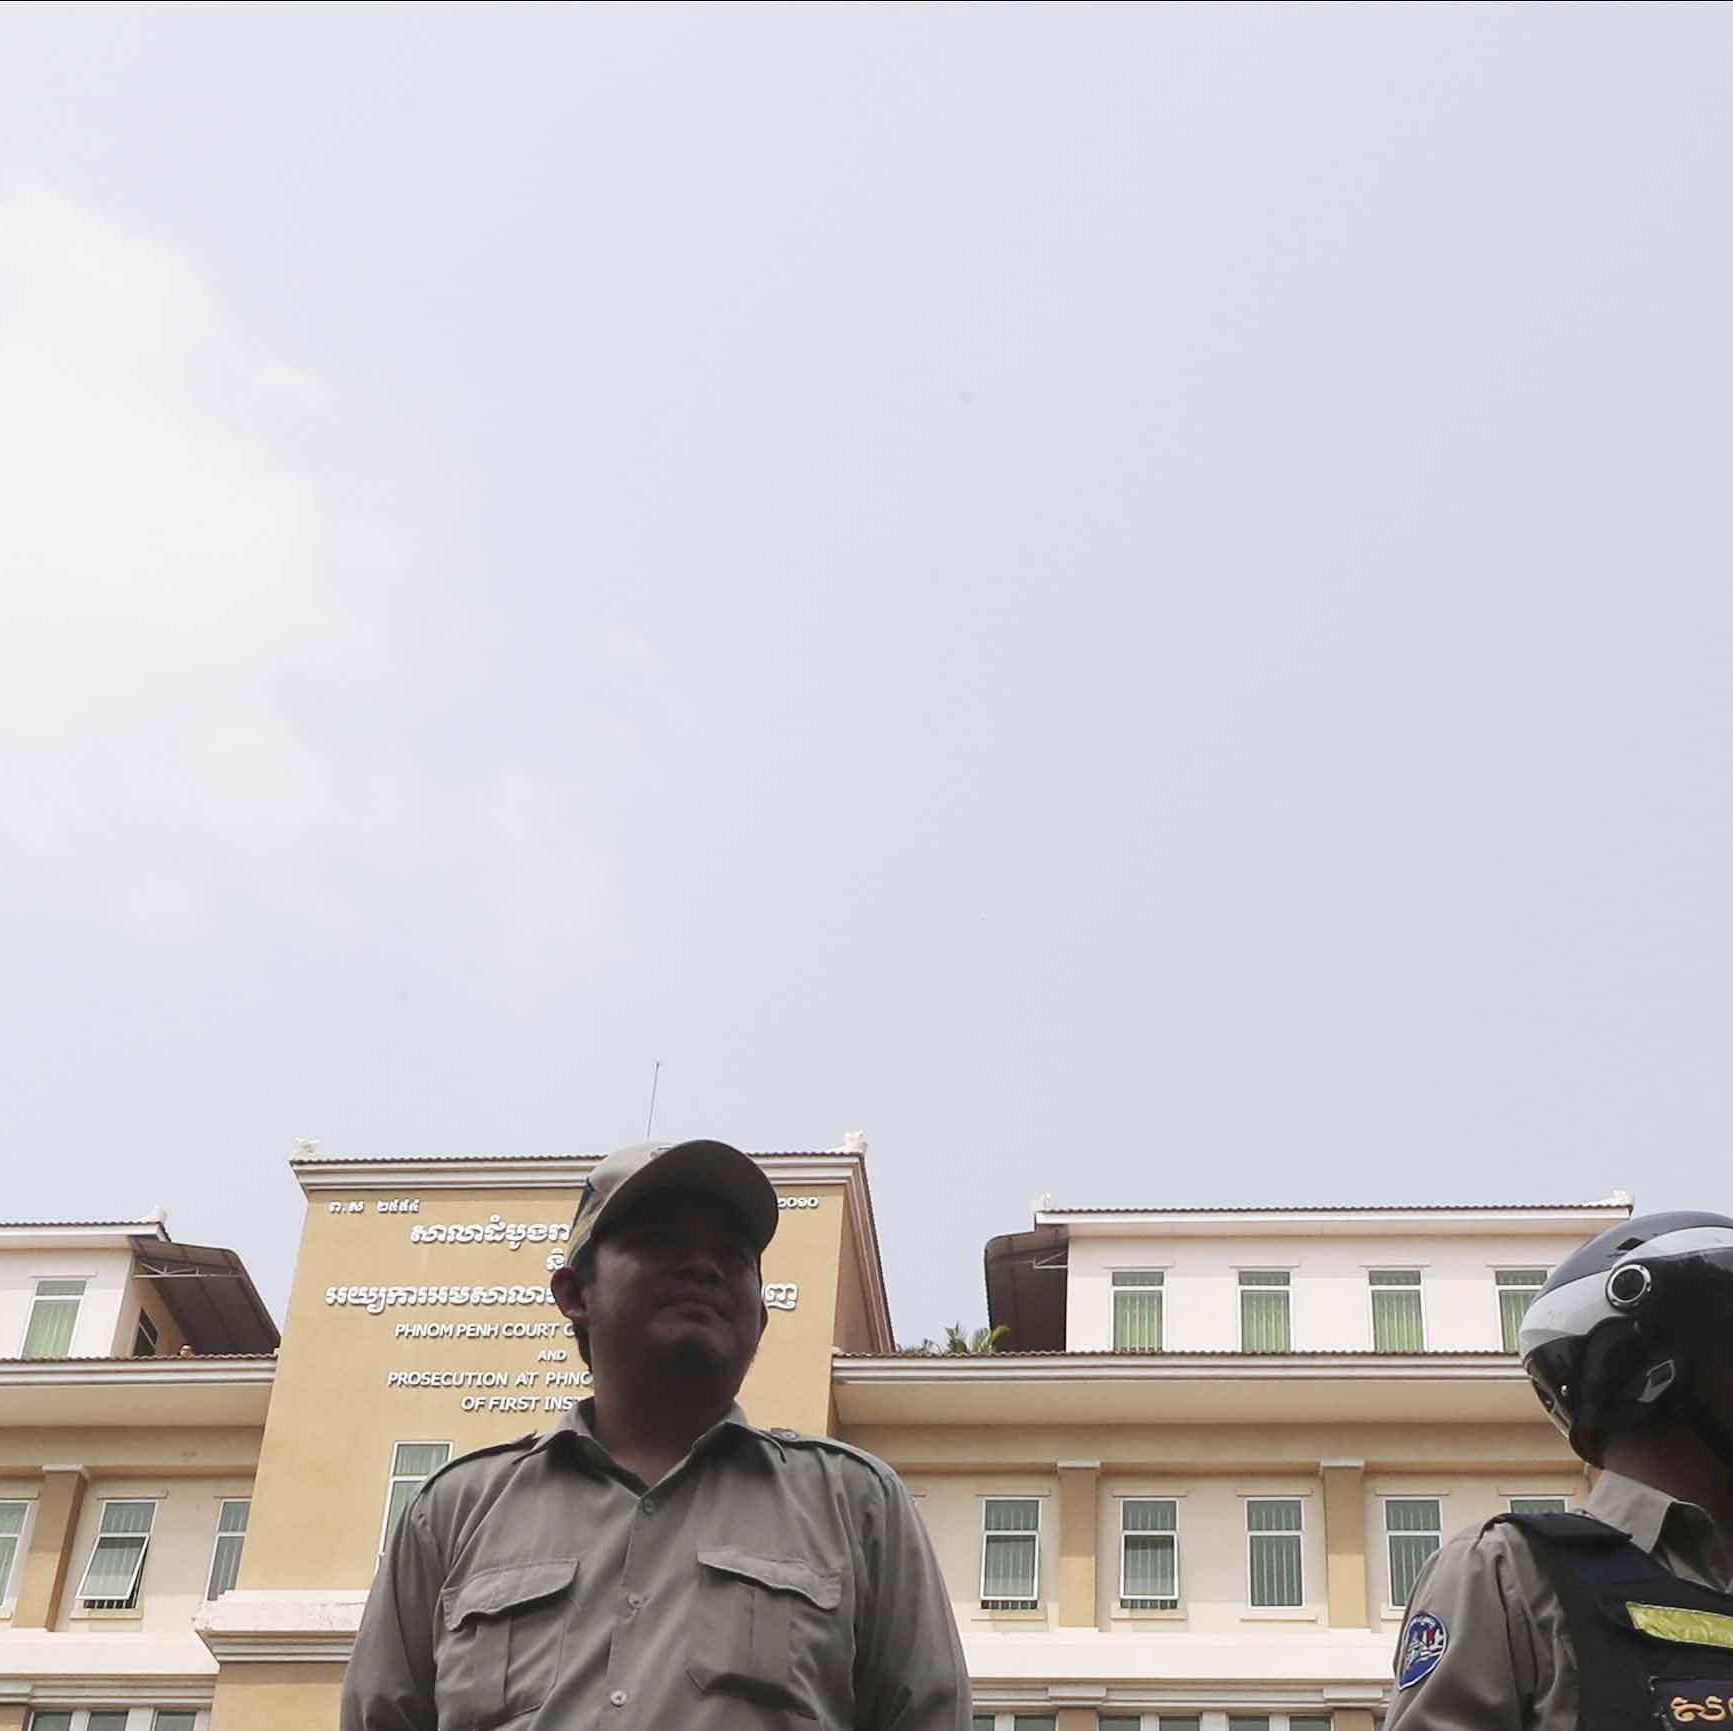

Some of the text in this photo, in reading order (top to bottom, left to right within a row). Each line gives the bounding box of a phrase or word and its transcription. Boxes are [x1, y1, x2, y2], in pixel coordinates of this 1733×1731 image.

[395, 1323, 454, 1337] PHNOM
[456, 1323, 500, 1337] PENH
[502, 1322, 560, 1337] COURT
[537, 1350, 567, 1362] AND
[387, 1372, 508, 1387] PROSECUTION
[515, 1372, 540, 1386] AT
[460, 1396, 487, 1411] OF
[488, 1396, 540, 1411] FIRST
